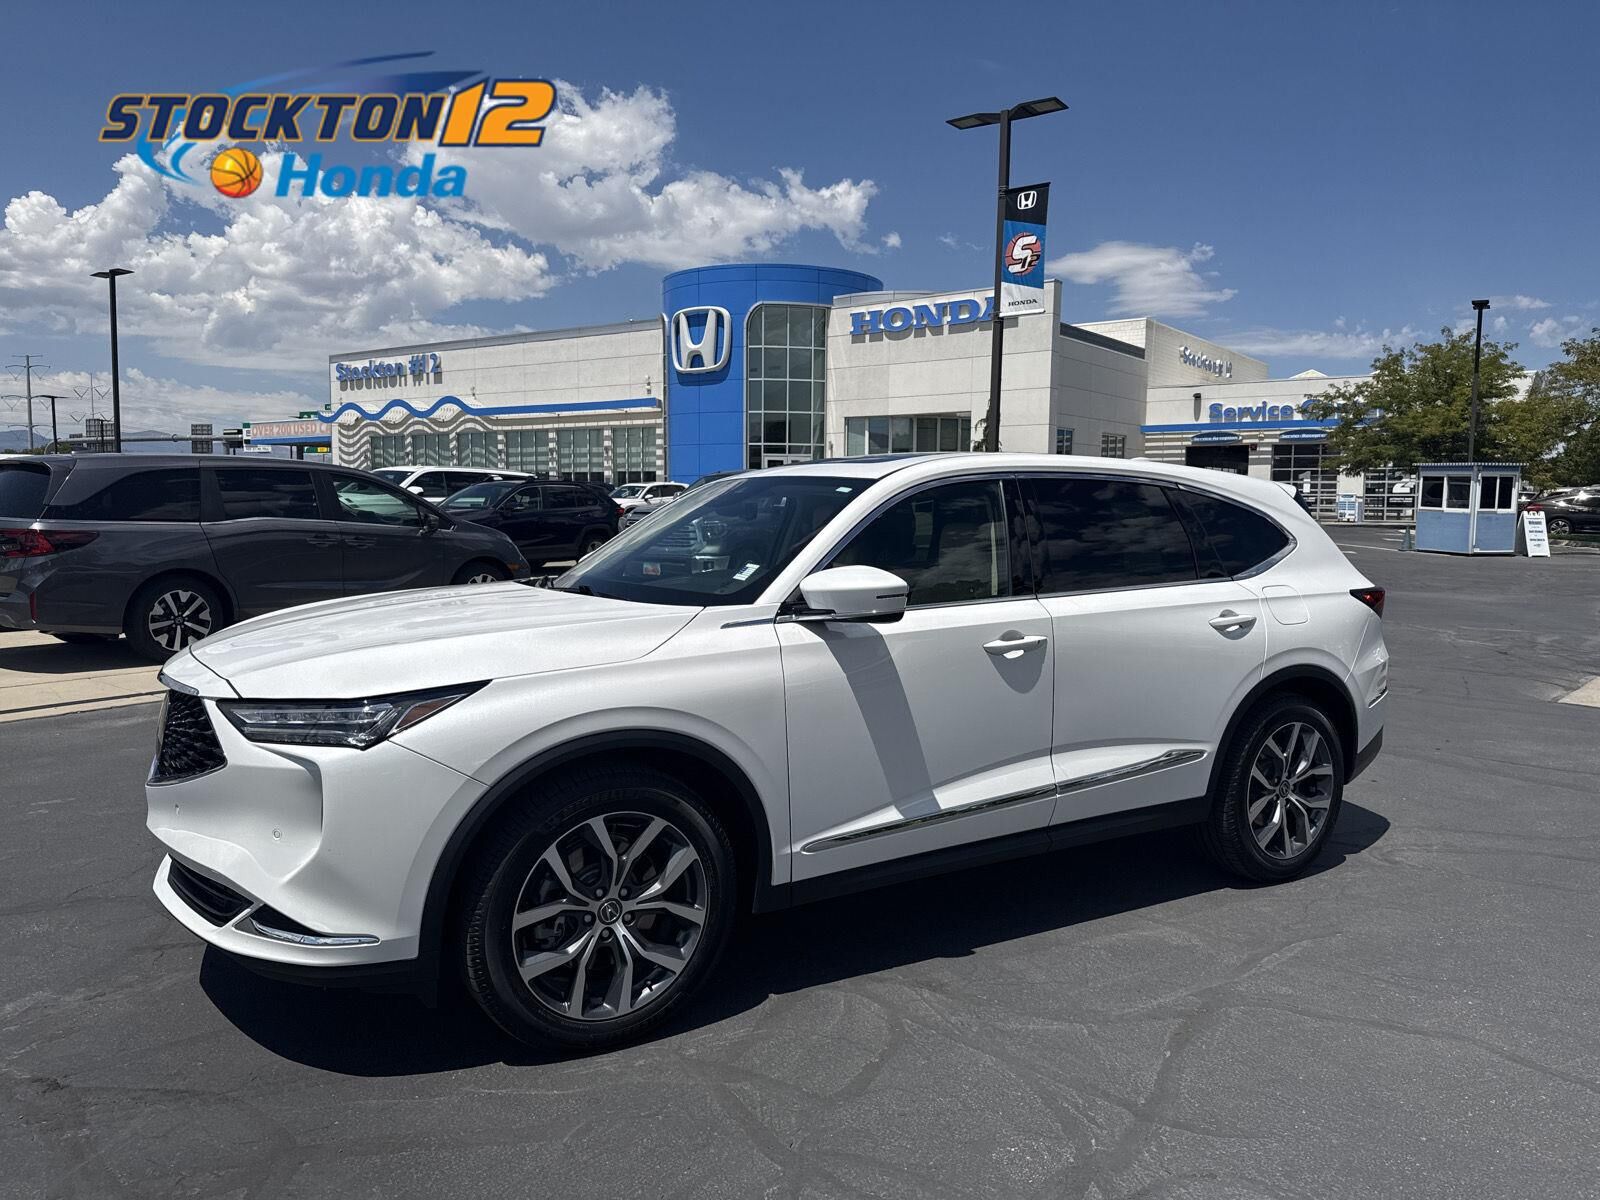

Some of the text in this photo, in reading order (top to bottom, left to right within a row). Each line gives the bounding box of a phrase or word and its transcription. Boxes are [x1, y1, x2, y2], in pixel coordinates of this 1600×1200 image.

[1008, 298, 1038, 307] HONDA
[336, 353, 441, 381] Stockton #12
[1209, 401, 1294, 421] Service
[252, 425, 274, 438] OVER
[275, 424, 292, 436] 200
[293, 422, 317, 435] USED
